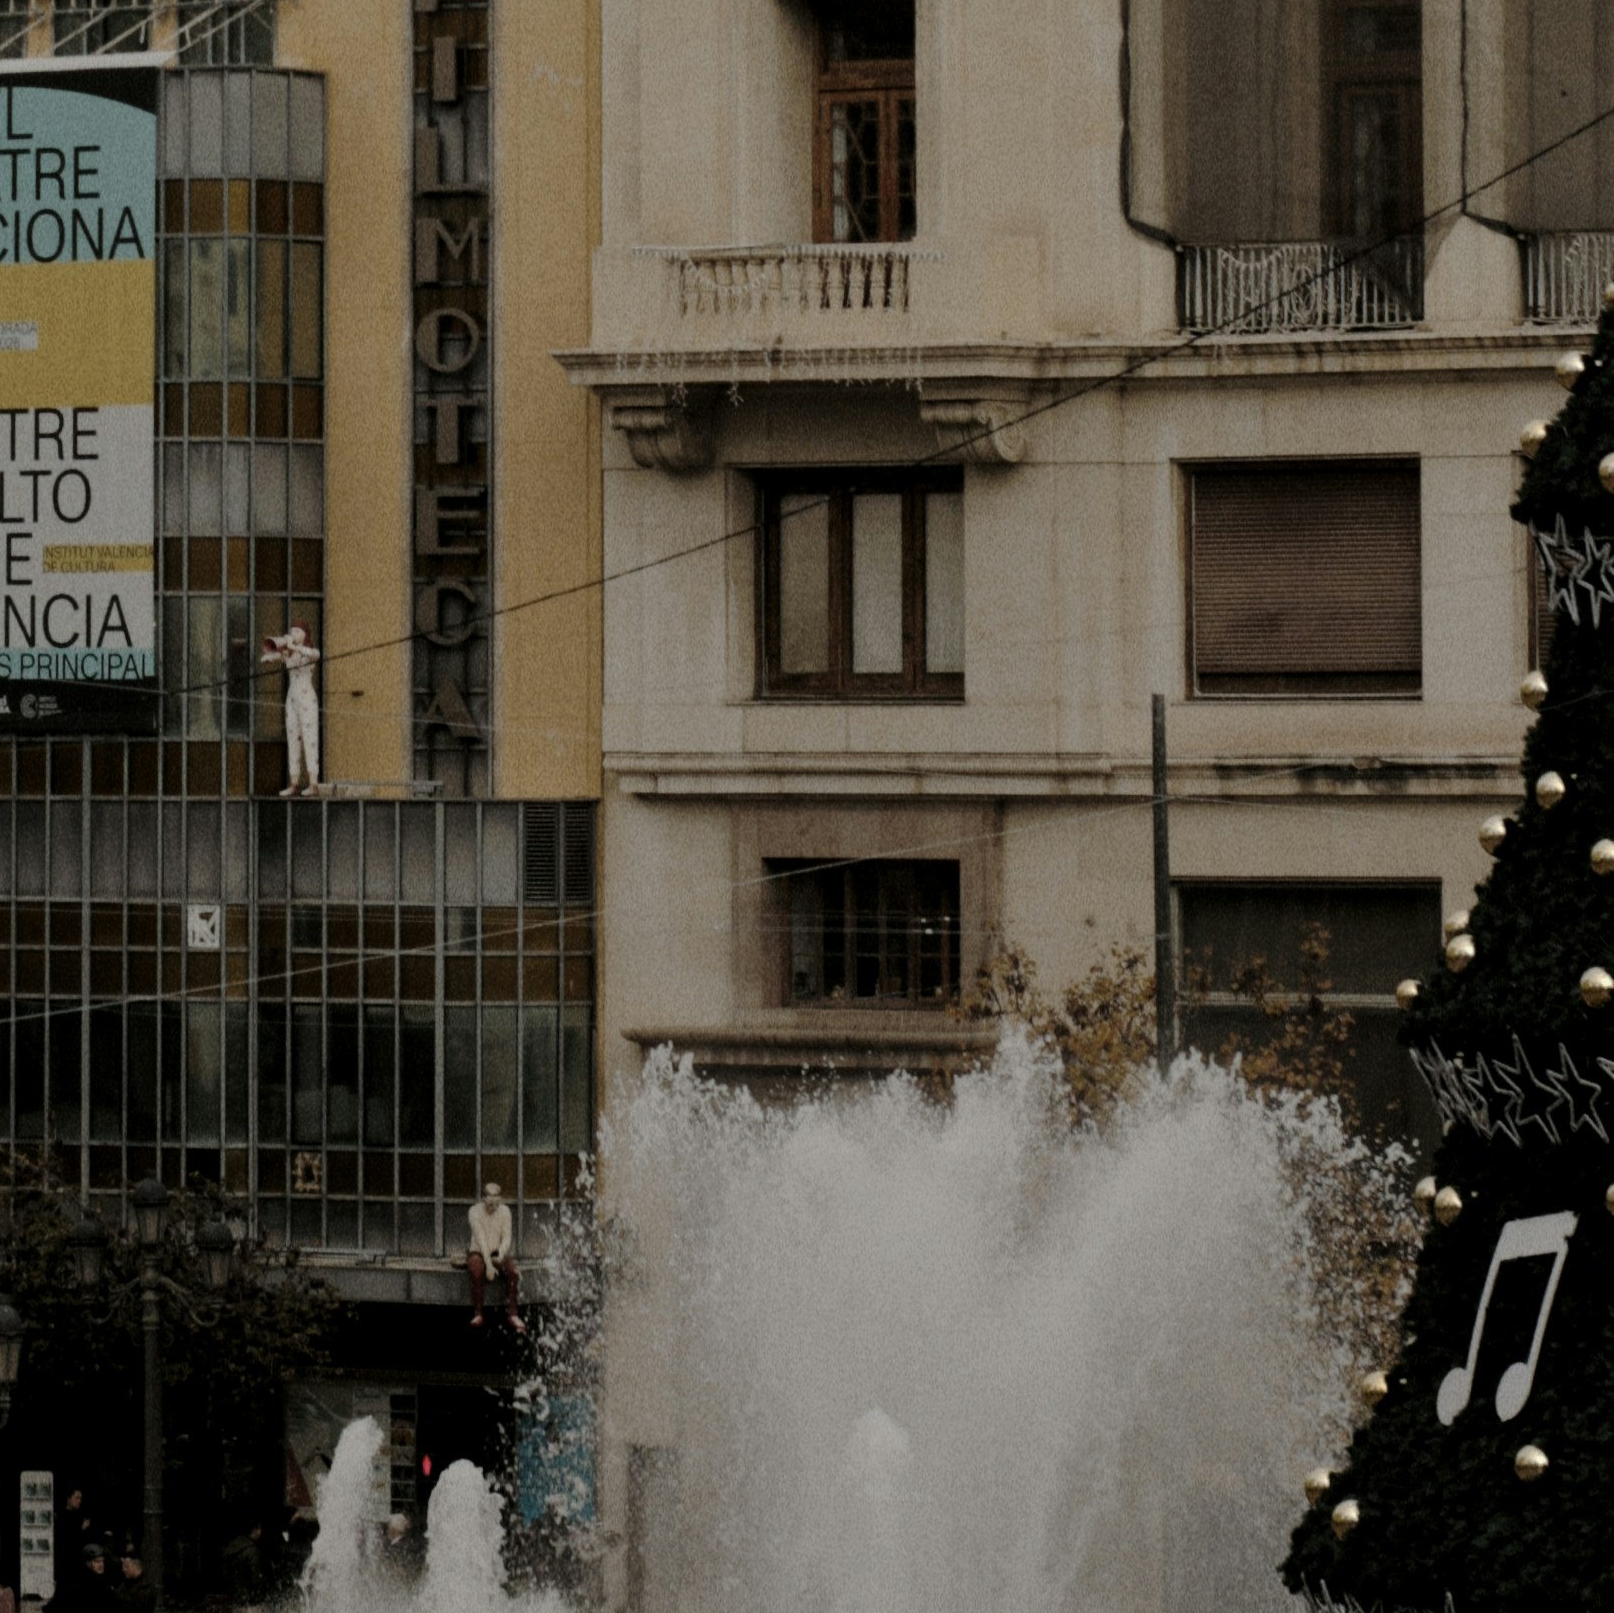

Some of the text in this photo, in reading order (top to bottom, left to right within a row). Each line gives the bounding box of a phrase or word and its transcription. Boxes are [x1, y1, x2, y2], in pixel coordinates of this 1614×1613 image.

[42, 545, 94, 559] INSTITUT
[42, 560, 116, 573] DE CULTURA
[20, 652, 147, 681] PRINCIPAL
